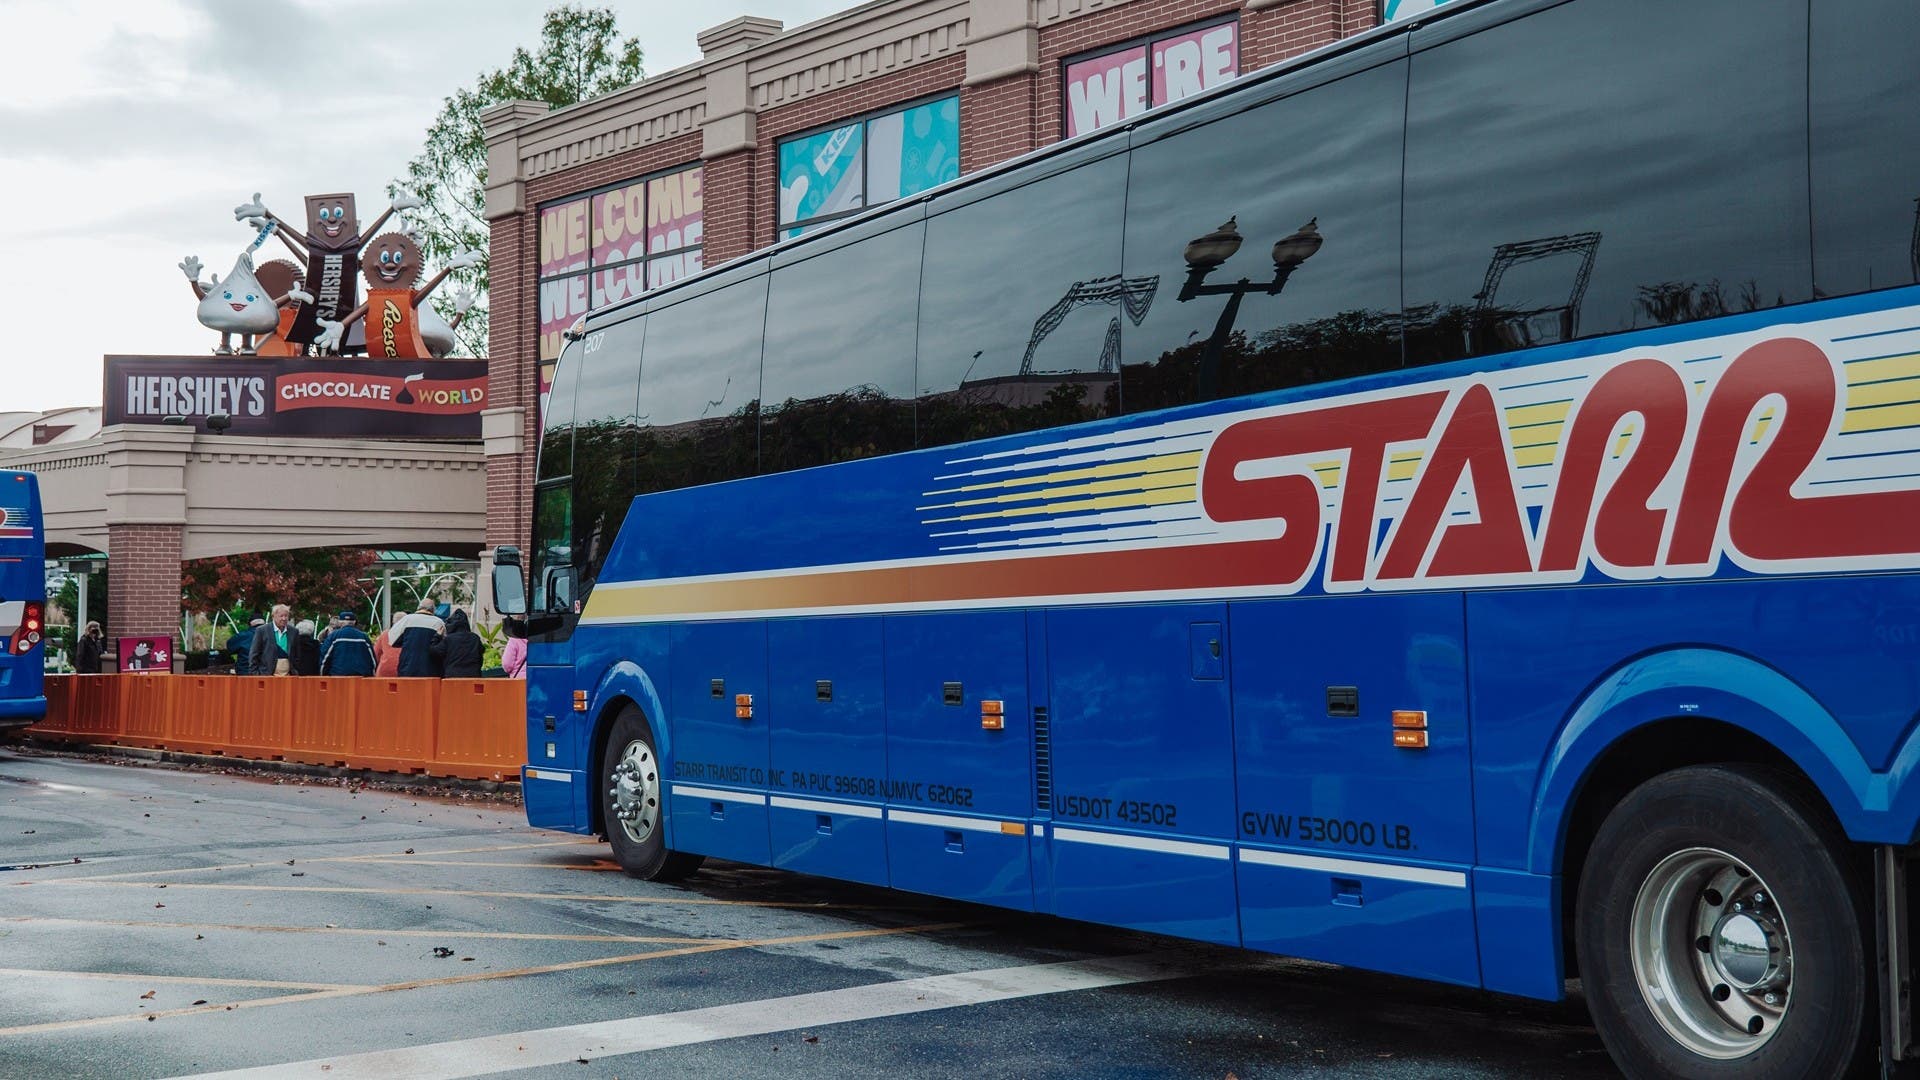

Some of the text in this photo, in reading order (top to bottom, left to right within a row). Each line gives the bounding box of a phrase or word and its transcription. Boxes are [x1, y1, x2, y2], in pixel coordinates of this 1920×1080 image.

[1069, 25, 1236, 136] WE'RE
[540, 166, 703, 267] WELCOME
[316, 254, 343, 318] HERSHEY'S
[540, 220, 703, 325] WELCOME
[584, 332, 605, 354] 207
[127, 375, 484, 417] HERSHEY'S CHOCOLATE WORLD
[1200, 336, 1850, 590] STARR
[674, 761, 705, 779] STARR
[707, 764, 747, 783] TRANSIT
[792, 771, 807, 790] PA
[810, 773, 831, 792] PUC
[834, 776, 875, 797] 99608
[928, 784, 973, 807] 62062
[1056, 794, 1177, 827] USDOT 43502
[1242, 811, 1418, 851] GVW 53000 LB.
